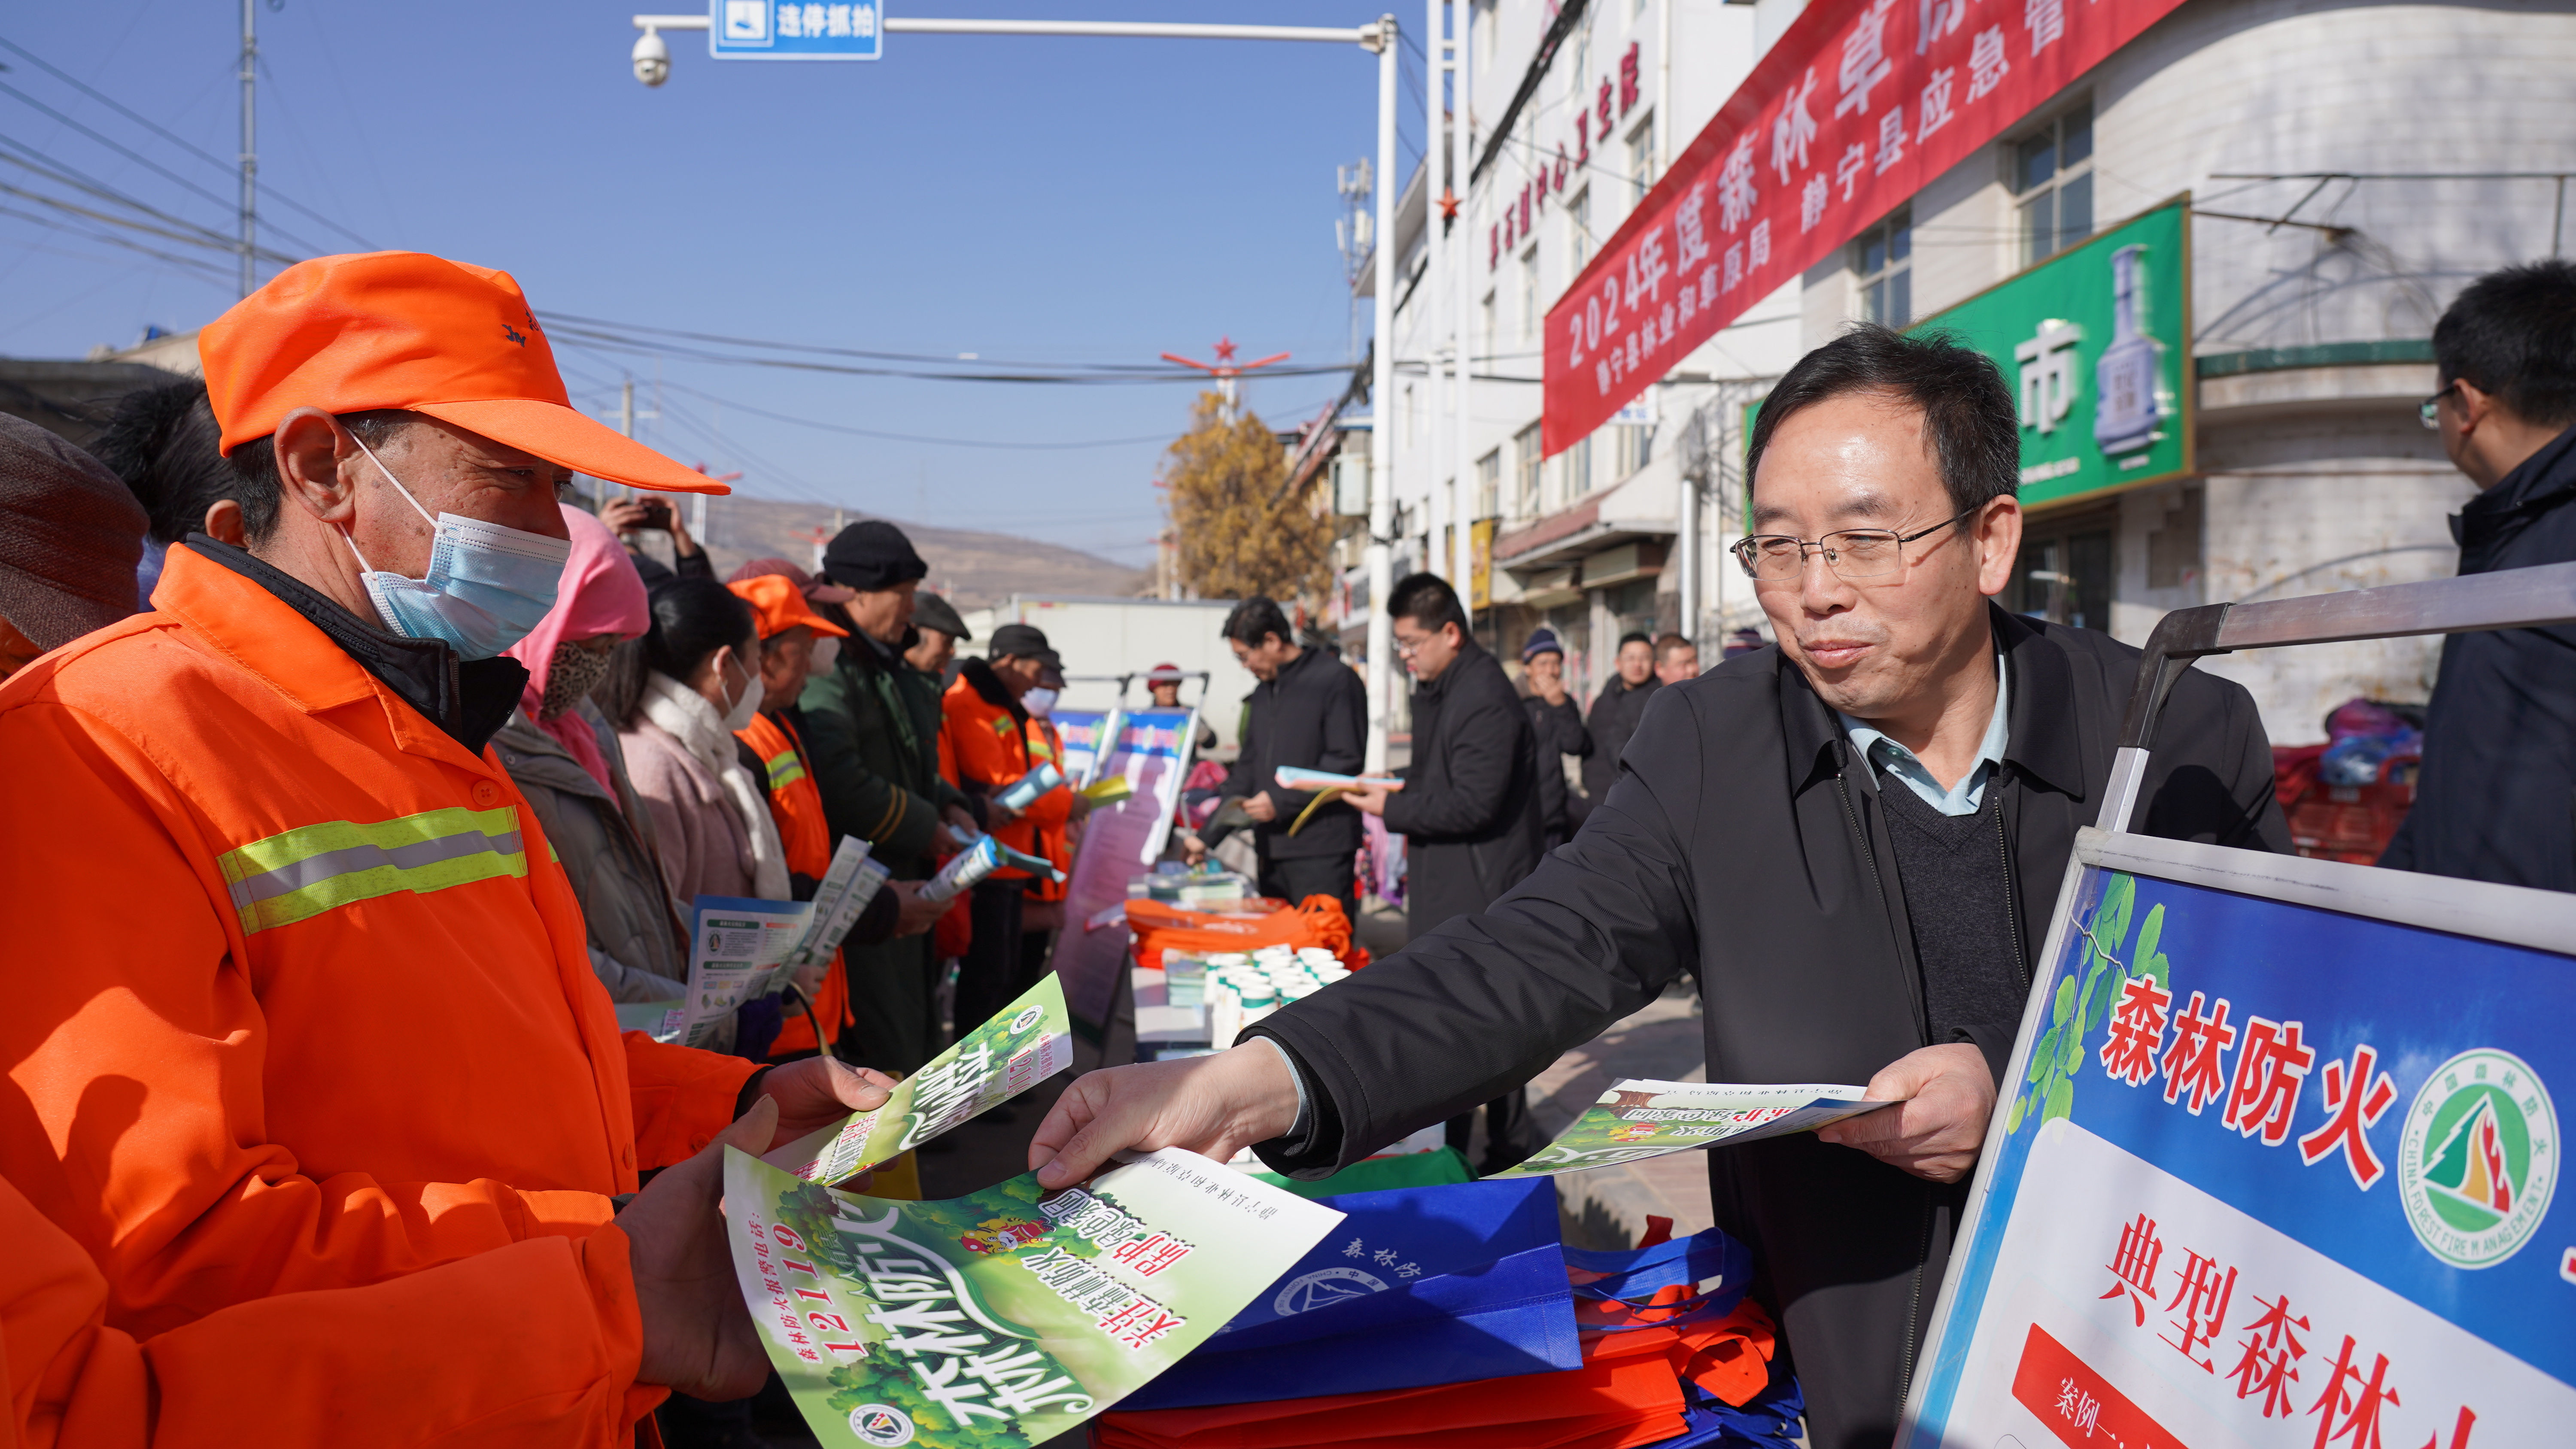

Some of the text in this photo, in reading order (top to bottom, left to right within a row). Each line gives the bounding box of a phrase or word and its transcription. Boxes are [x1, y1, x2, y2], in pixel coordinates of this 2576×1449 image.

[777, 3, 875, 38] 违停抓拍
[1595, 218, 1771, 396] 静宁县林业和草原局
[2014, 319, 2083, 434] 市
[1006, 1049, 1033, 1096] 12119
[2100, 974, 2397, 1191] 森林防火
[2422, 1063, 2548, 1156] 中国森林防火
[1152, 1158, 1278, 1220] 静宁县林业和草原局
[2406, 1137, 2418, 1188] CHINA
[1041, 1190, 1191, 1277] 保护绿色家园
[2410, 1190, 2442, 1240] FOREST
[2439, 1233, 2467, 1256] FIRE
[773, 1224, 866, 1355] 12119
[1024, 1248, 1182, 1349] 关注森林防火
[1284, 1279, 1303, 1297] FOREST
[1306, 1270, 1332, 1279] CHINA
